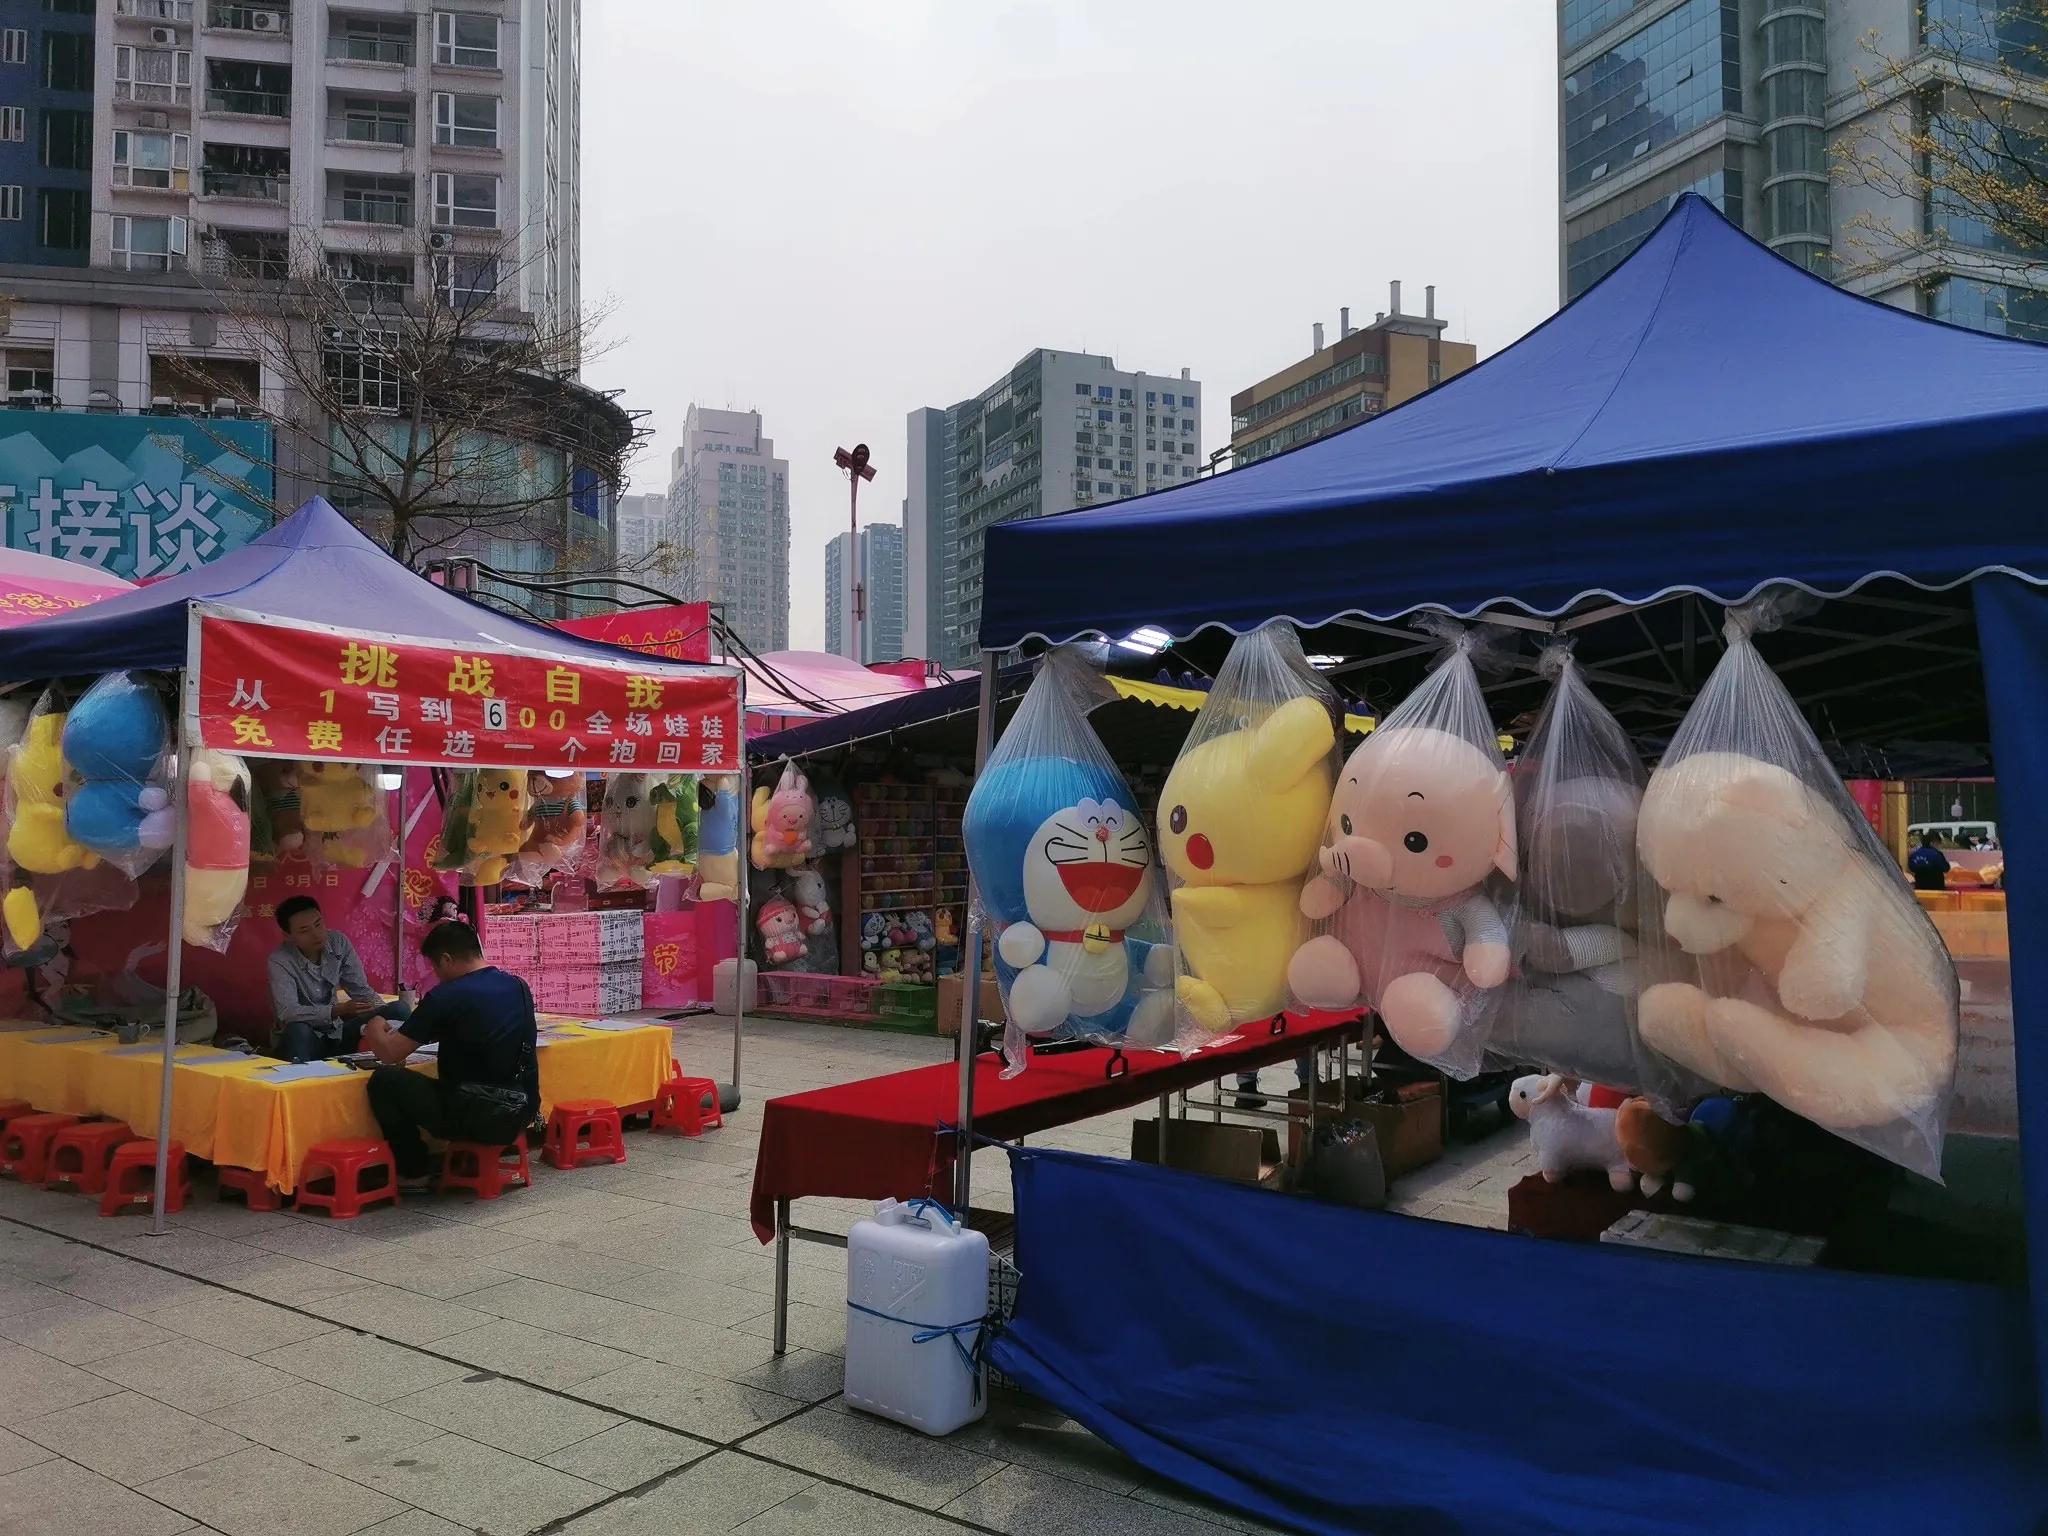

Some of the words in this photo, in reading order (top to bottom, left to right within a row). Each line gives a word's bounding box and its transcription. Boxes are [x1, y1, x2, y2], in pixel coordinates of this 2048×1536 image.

[339, 641, 664, 710] 挑战自我
[230, 714, 725, 765] 免费任选一个抱回家
